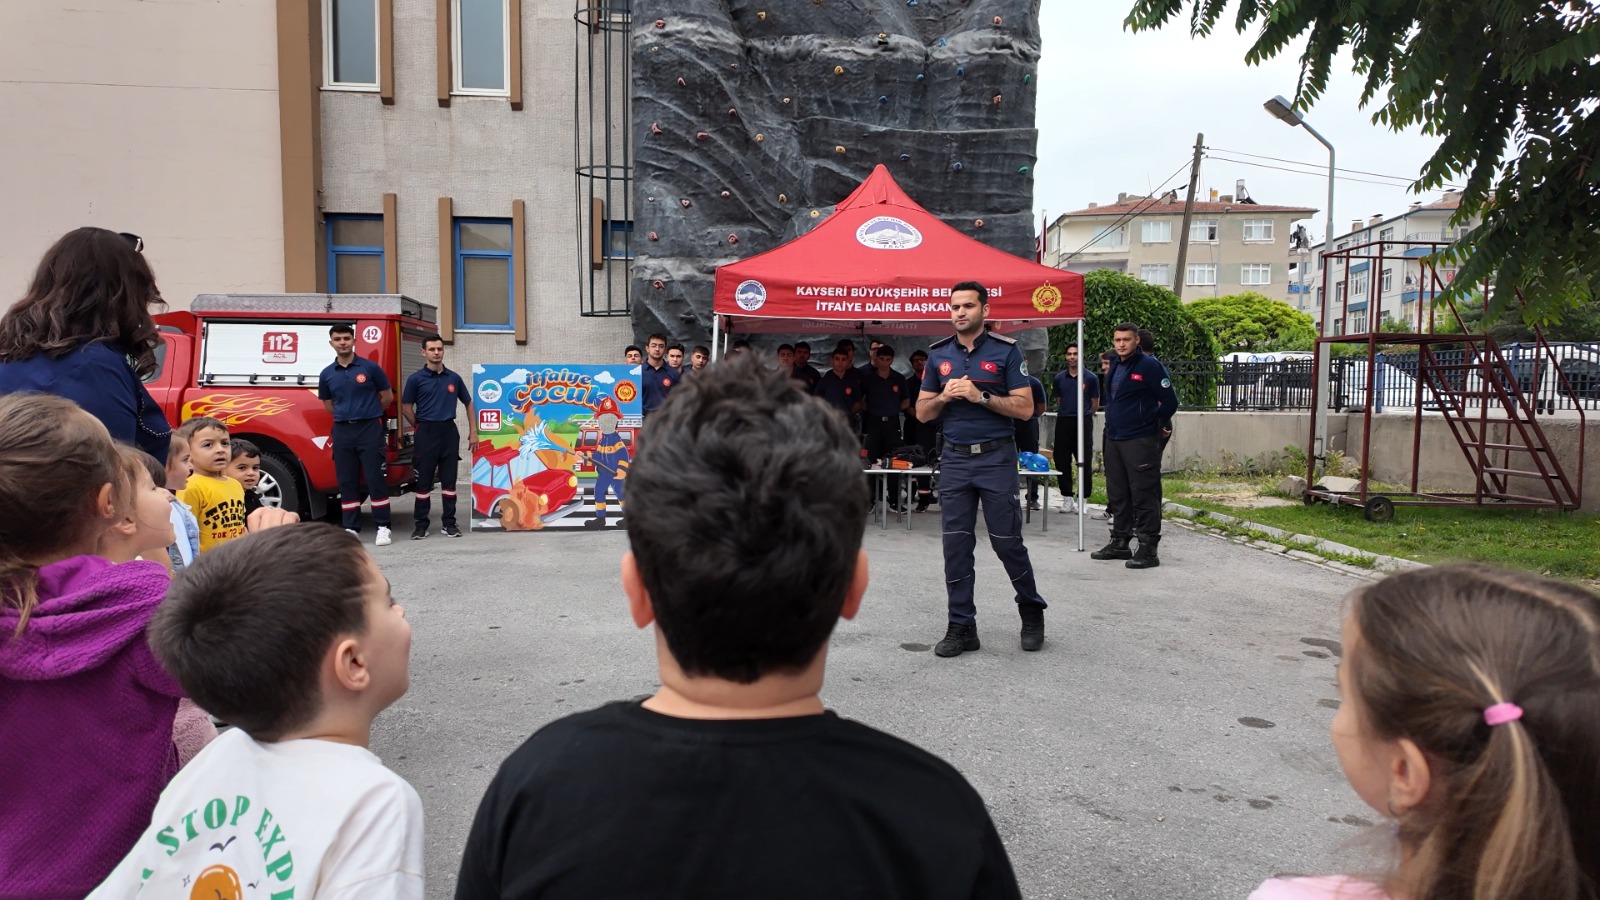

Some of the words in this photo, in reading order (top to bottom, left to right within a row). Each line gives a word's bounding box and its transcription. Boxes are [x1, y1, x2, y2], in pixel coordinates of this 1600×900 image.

[796, 285, 847, 297] KAYSERİ
[851, 286, 930, 299] BÜYÜKŞEHİR
[816, 300, 862, 312] İTFAİYE
[865, 301, 901, 312] DAİRE
[364, 328, 379, 341] 42
[268, 333, 294, 351] 112
[482, 411, 498, 422] 112
[156, 794, 251, 857] STOP
